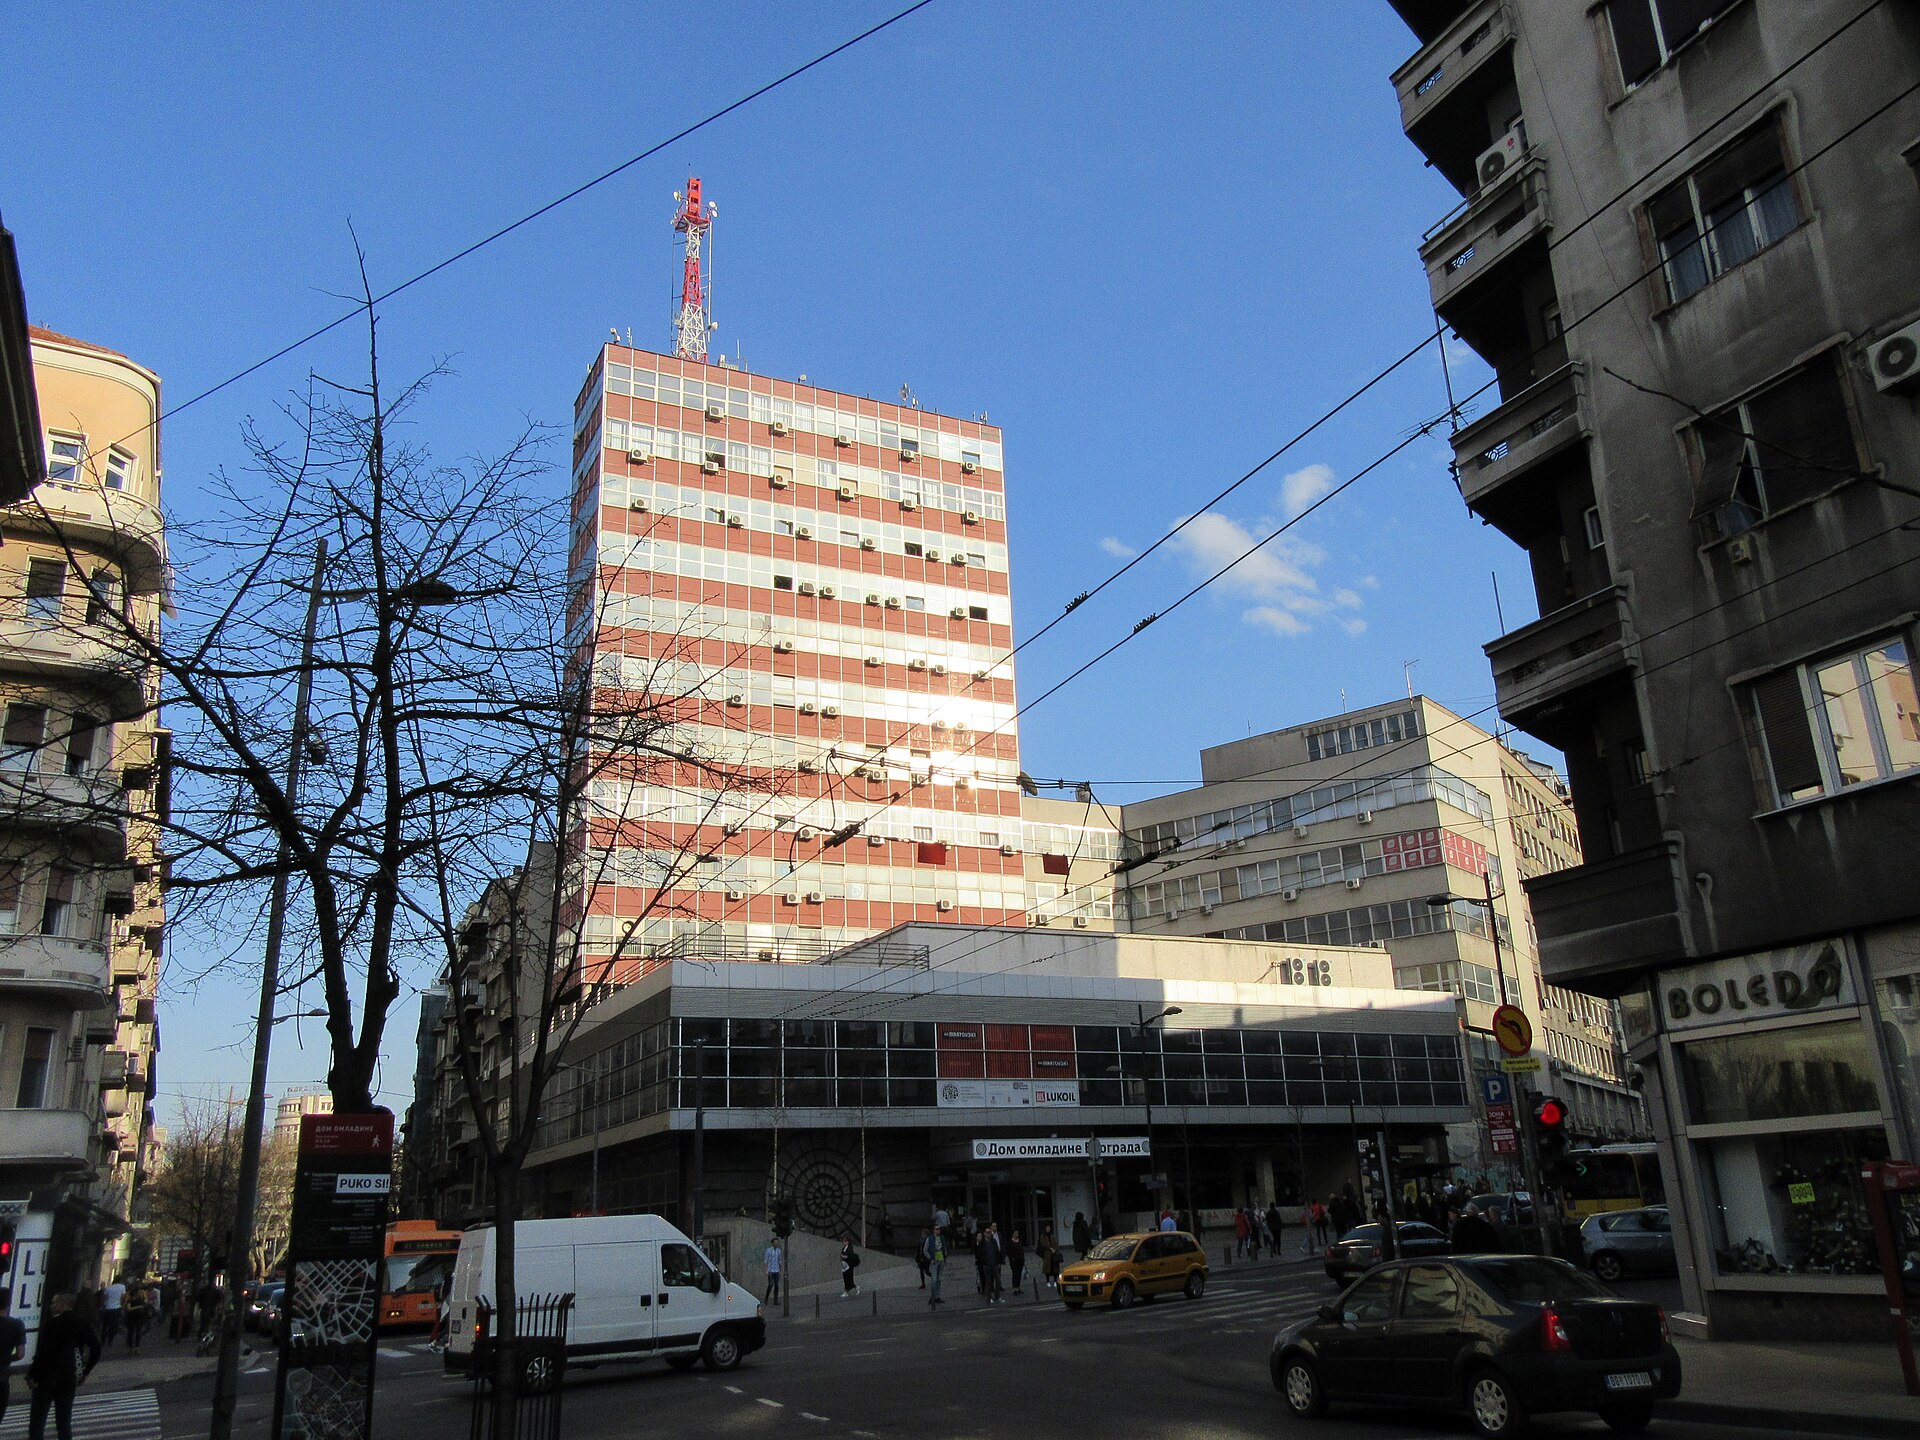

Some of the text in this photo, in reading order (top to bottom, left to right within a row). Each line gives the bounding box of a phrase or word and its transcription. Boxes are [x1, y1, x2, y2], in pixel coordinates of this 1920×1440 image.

[1046, 1092, 1076, 1102] LUKOIL
[315, 1125, 375, 1133] ДОМ ОМЛАДИНЕ
[988, 1143, 1016, 1156] Дом
[1019, 1144, 1082, 1155] омладине
[340, 1178, 371, 1189] PUKO
[375, 1178, 389, 1188] SI!
